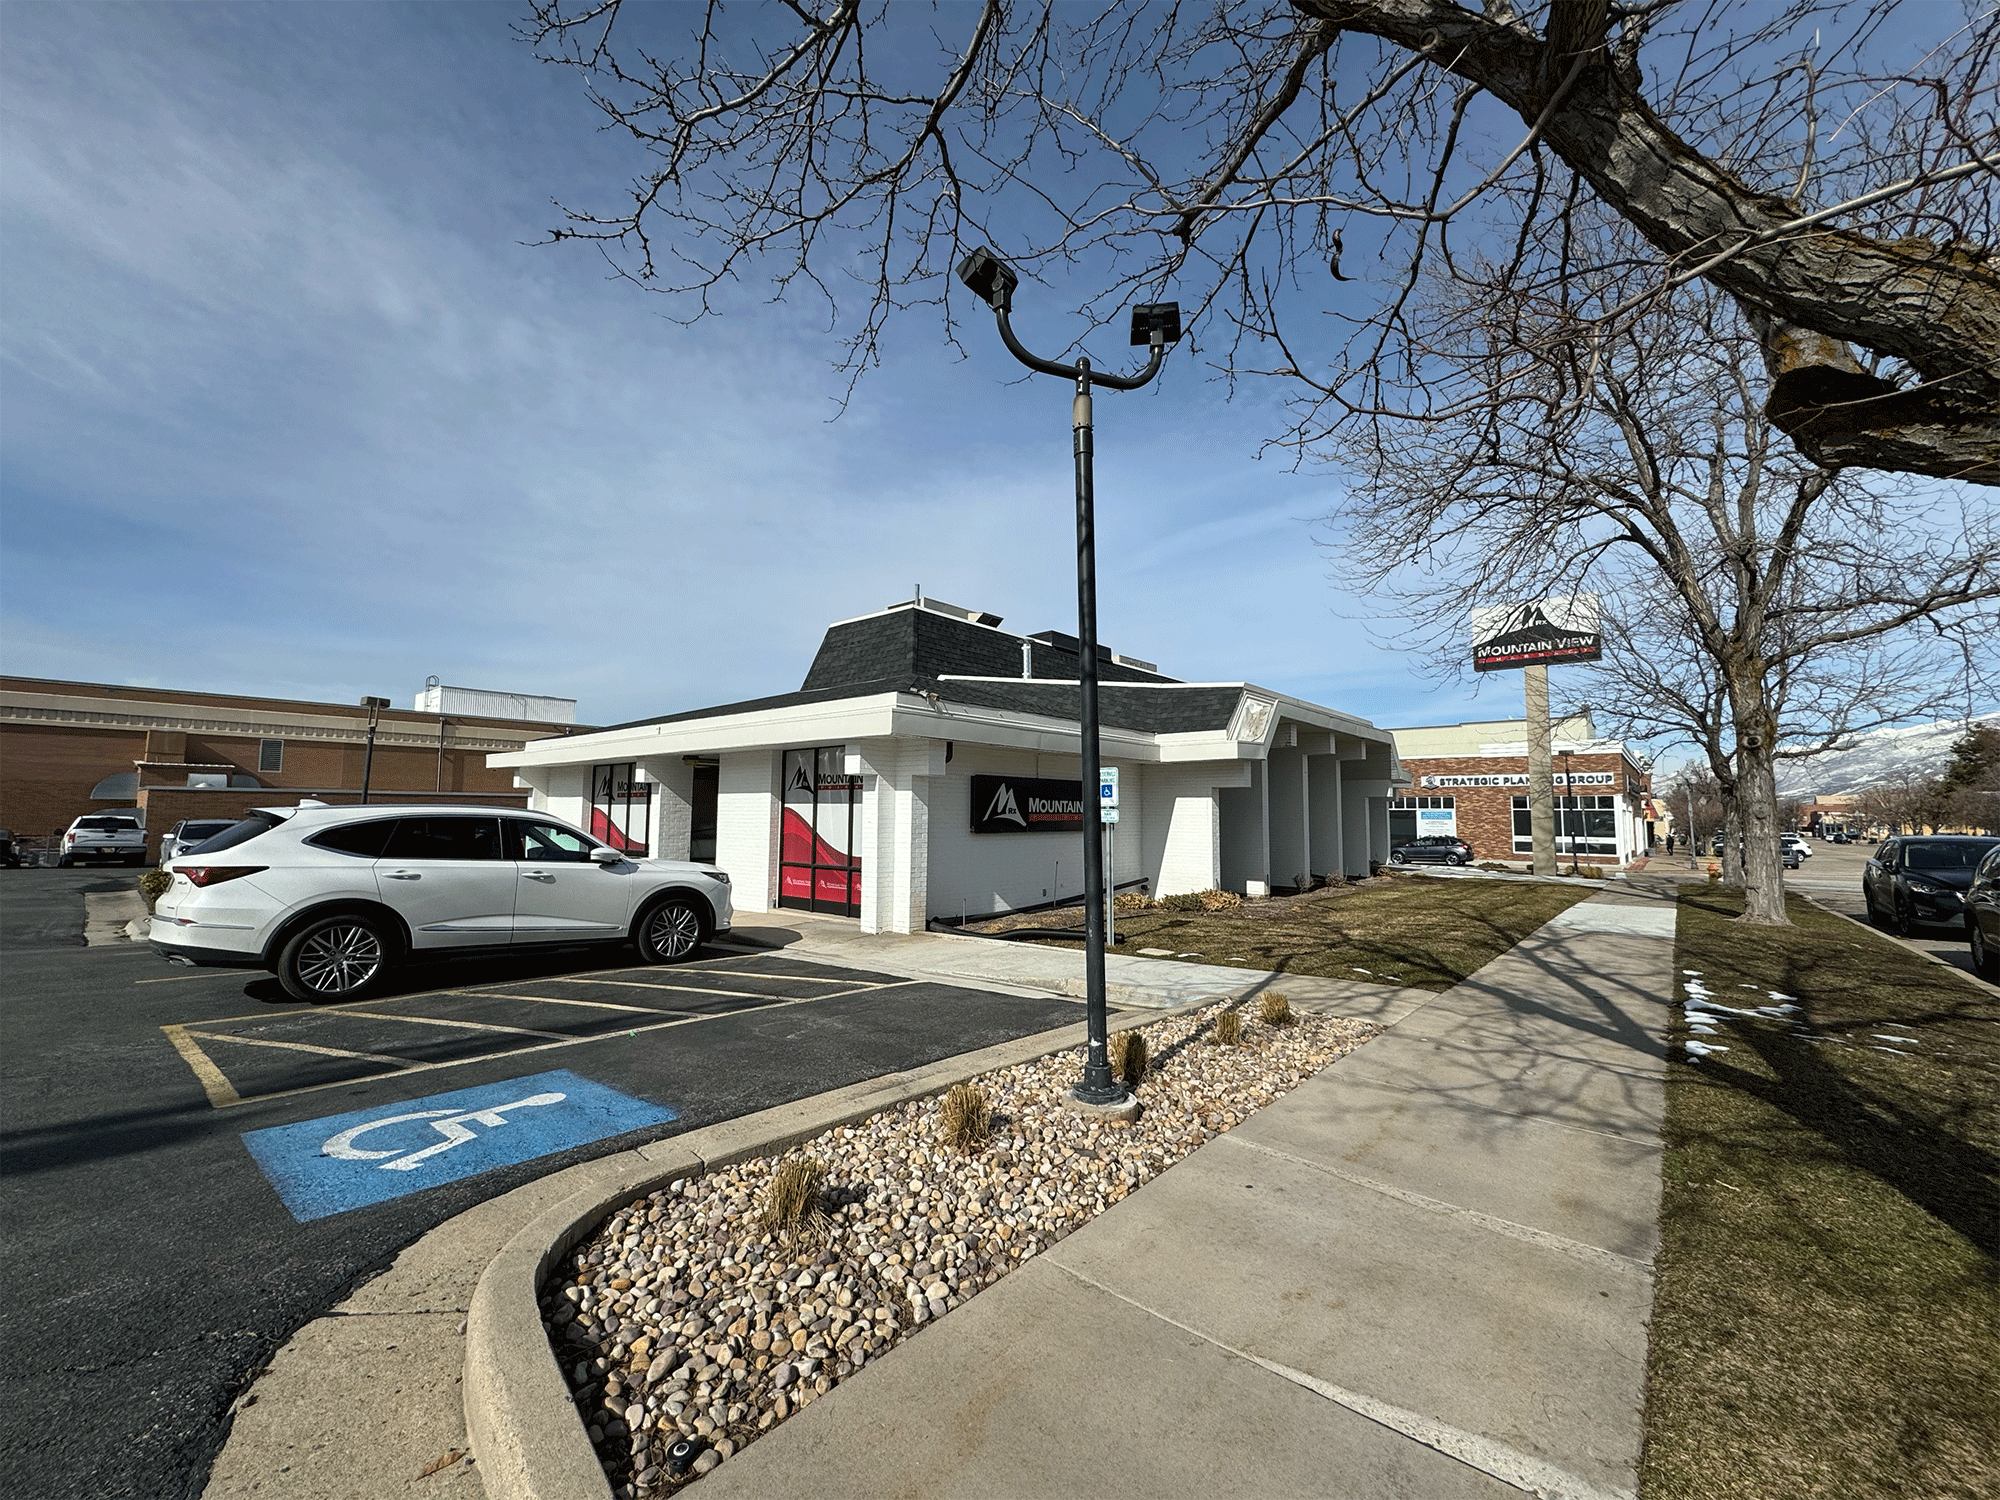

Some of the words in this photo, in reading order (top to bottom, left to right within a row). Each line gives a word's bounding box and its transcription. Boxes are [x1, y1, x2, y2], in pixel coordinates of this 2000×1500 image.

[1478, 641, 1552, 658] MOUNTAIN
[1555, 635, 1595, 648] VIEW
[1439, 776, 1500, 786] STRATEGIC
[1568, 774, 1613, 785] GROUP
[1028, 797, 1084, 813] MOUNTAIN
